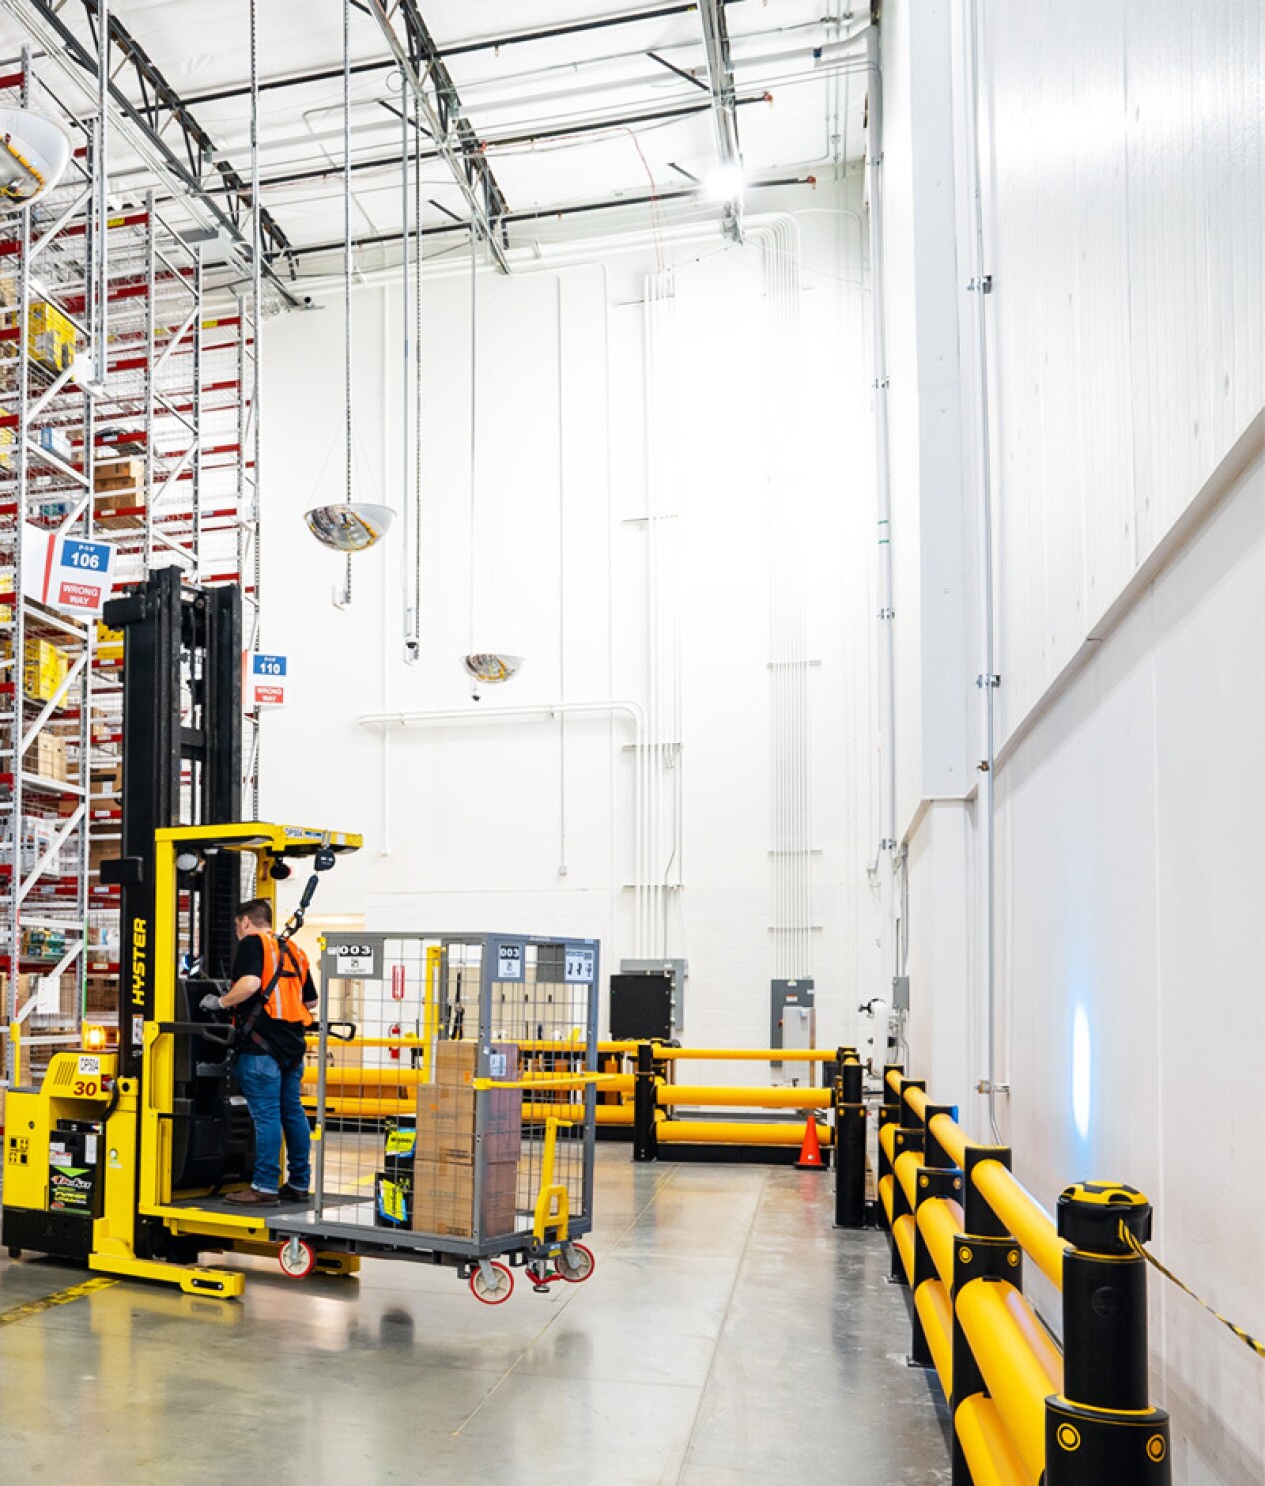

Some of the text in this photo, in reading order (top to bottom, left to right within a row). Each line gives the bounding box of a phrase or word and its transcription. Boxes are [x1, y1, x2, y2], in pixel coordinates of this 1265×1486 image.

[71, 552, 100, 569] 106
[62, 584, 99, 596] WRONG
[69, 595, 89, 605] WAY
[260, 662, 281, 674] 110
[339, 944, 371, 956] 003
[499, 947, 519, 958] 003
[132, 917, 147, 1006] HYSTER
[73, 1081, 97, 1096] 30
